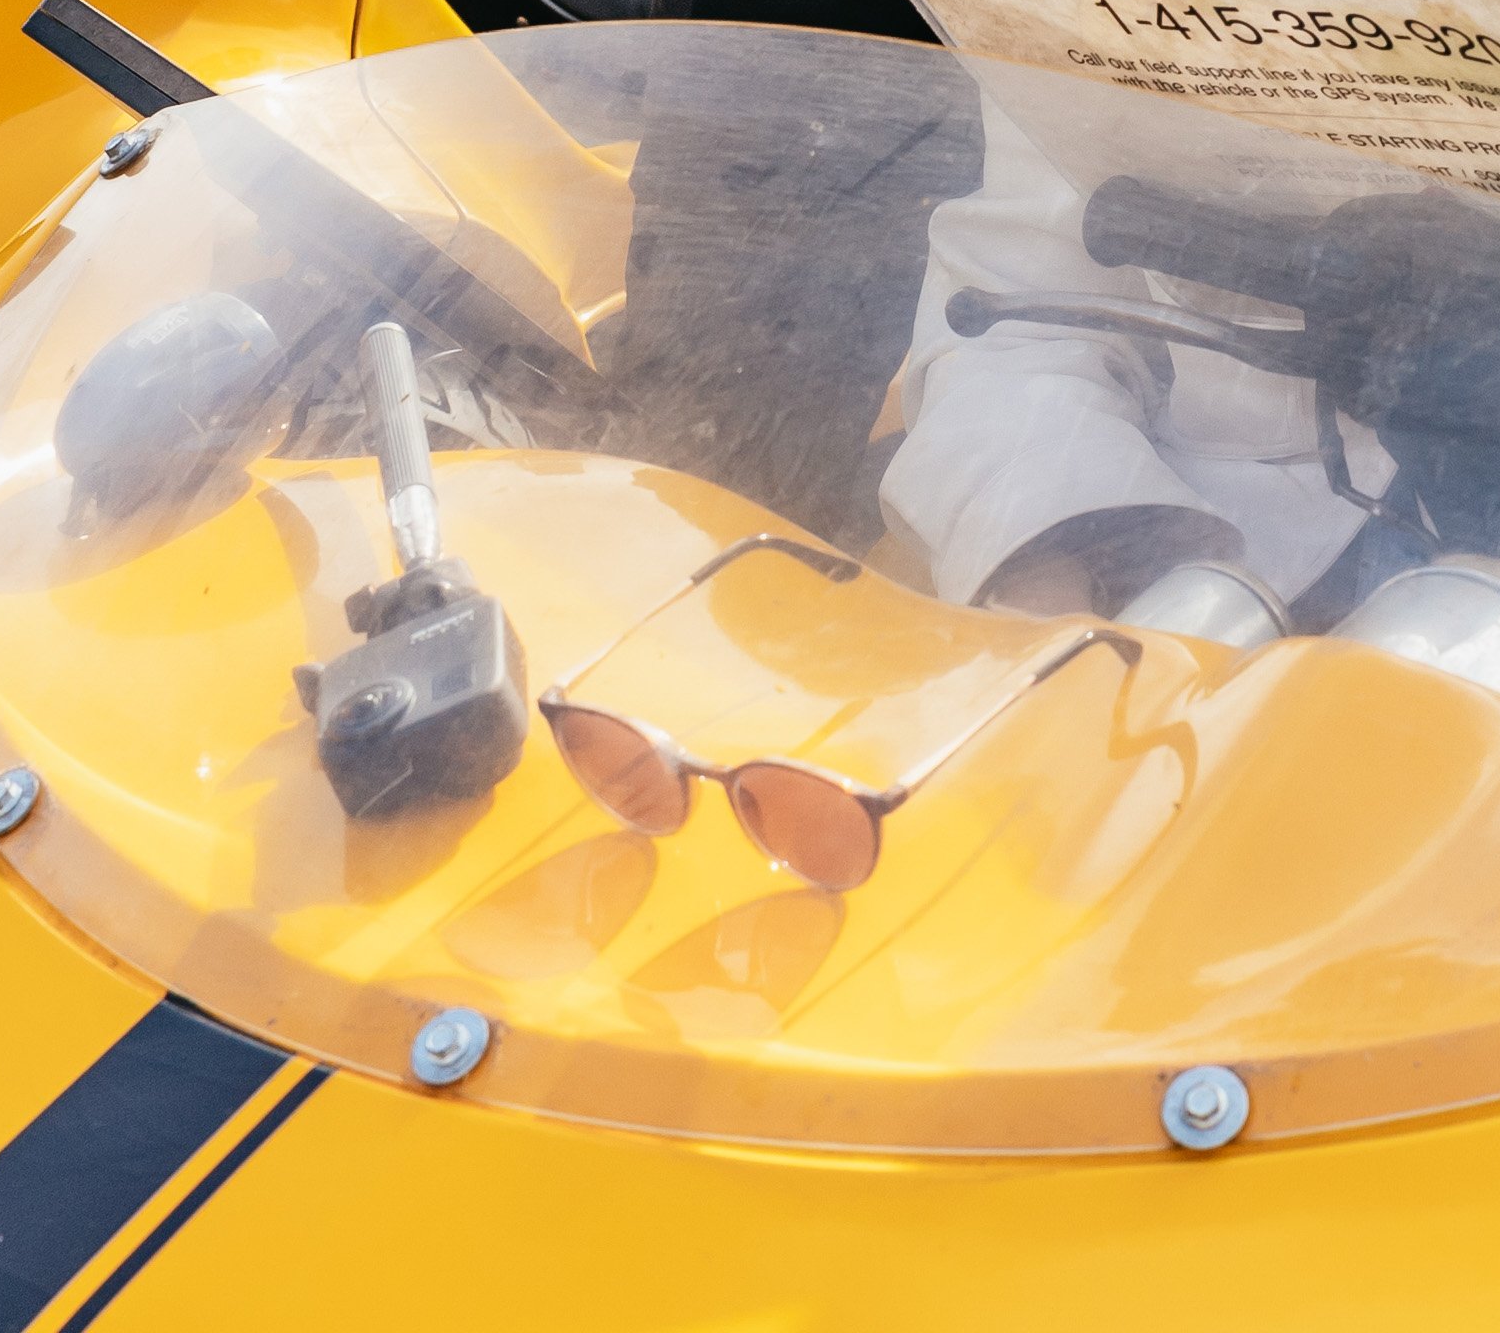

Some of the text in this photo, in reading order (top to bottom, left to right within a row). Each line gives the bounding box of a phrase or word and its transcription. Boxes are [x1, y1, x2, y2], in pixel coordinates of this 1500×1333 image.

[1067, 49, 1104, 68] Call
[1108, 55, 1138, 72] our
[1140, 58, 1182, 76] field
[1185, 64, 1261, 81] support
[1260, 66, 1298, 82] line
[1300, 68, 1315, 81] if
[1319, 71, 1355, 86] you
[1357, 71, 1411, 85] have
[1414, 76, 1452, 92] any
[1111, 75, 1151, 90] with
[1152, 77, 1186, 95] the
[1191, 81, 1257, 98] vehicle
[1260, 86, 1281, 98] or
[1284, 85, 1318, 100] the
[1320, 85, 1369, 103] GPS
[1374, 90, 1454, 107] system.
[1457, 94, 1497, 111] We
[1348, 132, 1462, 153] STARTING
